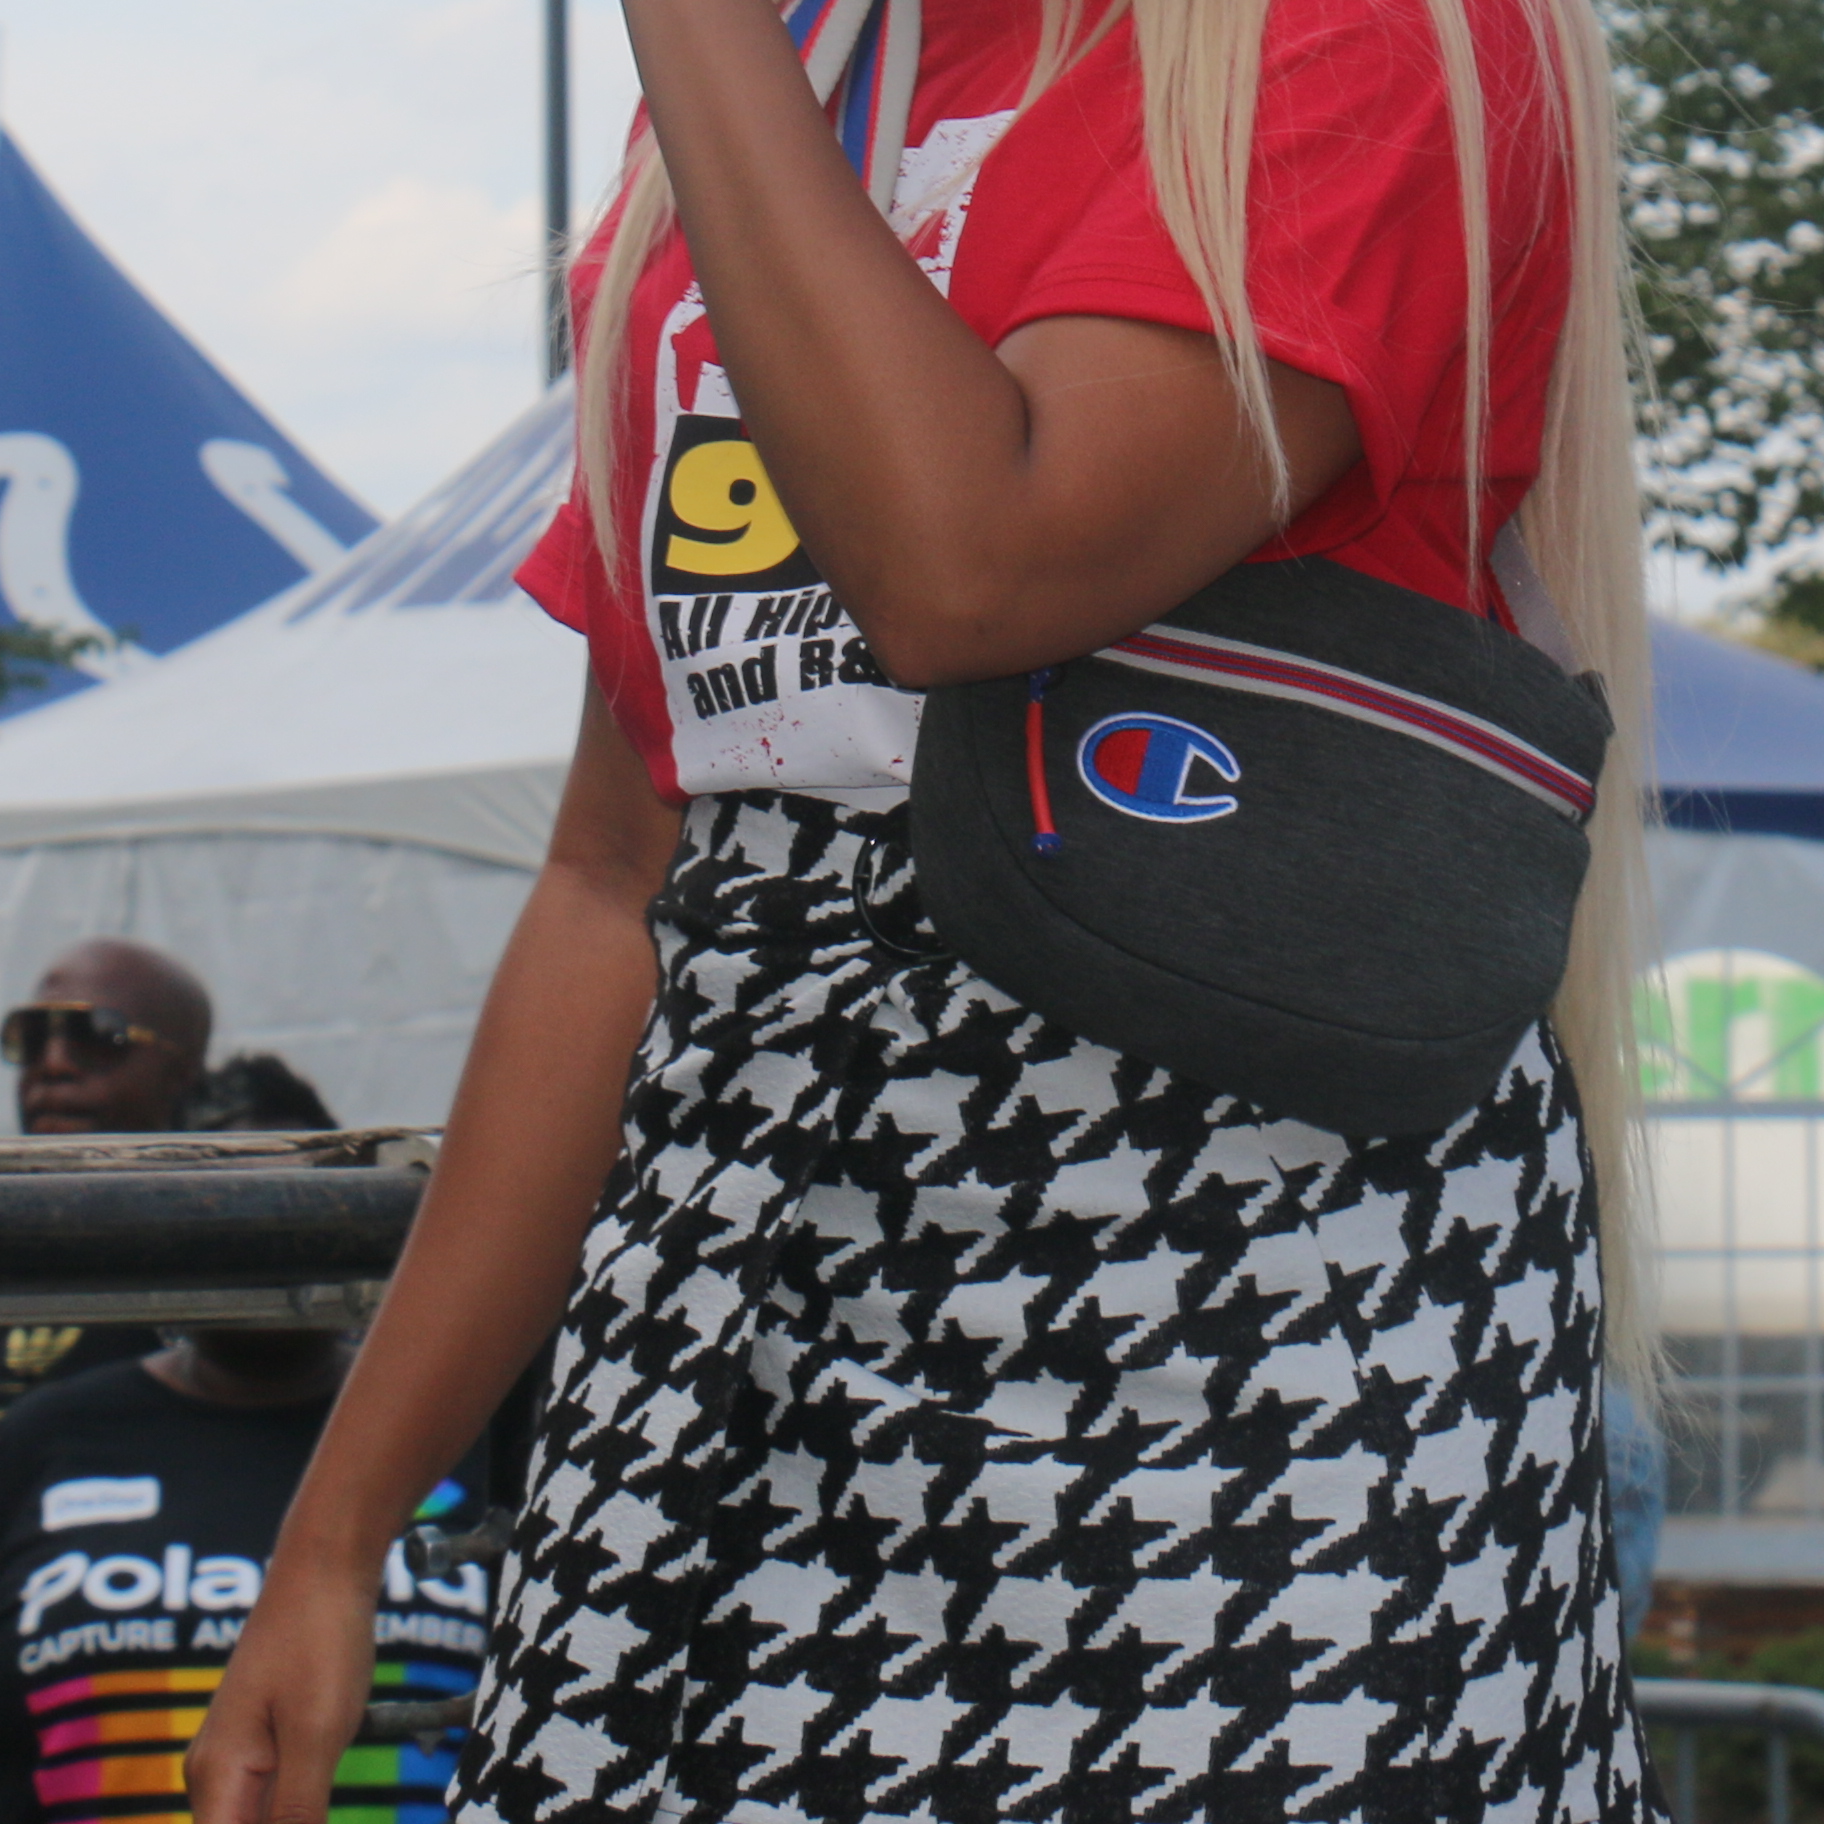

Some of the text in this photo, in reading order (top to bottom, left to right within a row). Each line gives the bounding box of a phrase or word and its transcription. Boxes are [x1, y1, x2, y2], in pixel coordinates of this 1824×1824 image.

[659, 594, 734, 662] All
[686, 644, 778, 720] and
[17, 1541, 489, 1637] Polaid
[18, 1610, 489, 1674] CAPTURE AN EMBER
